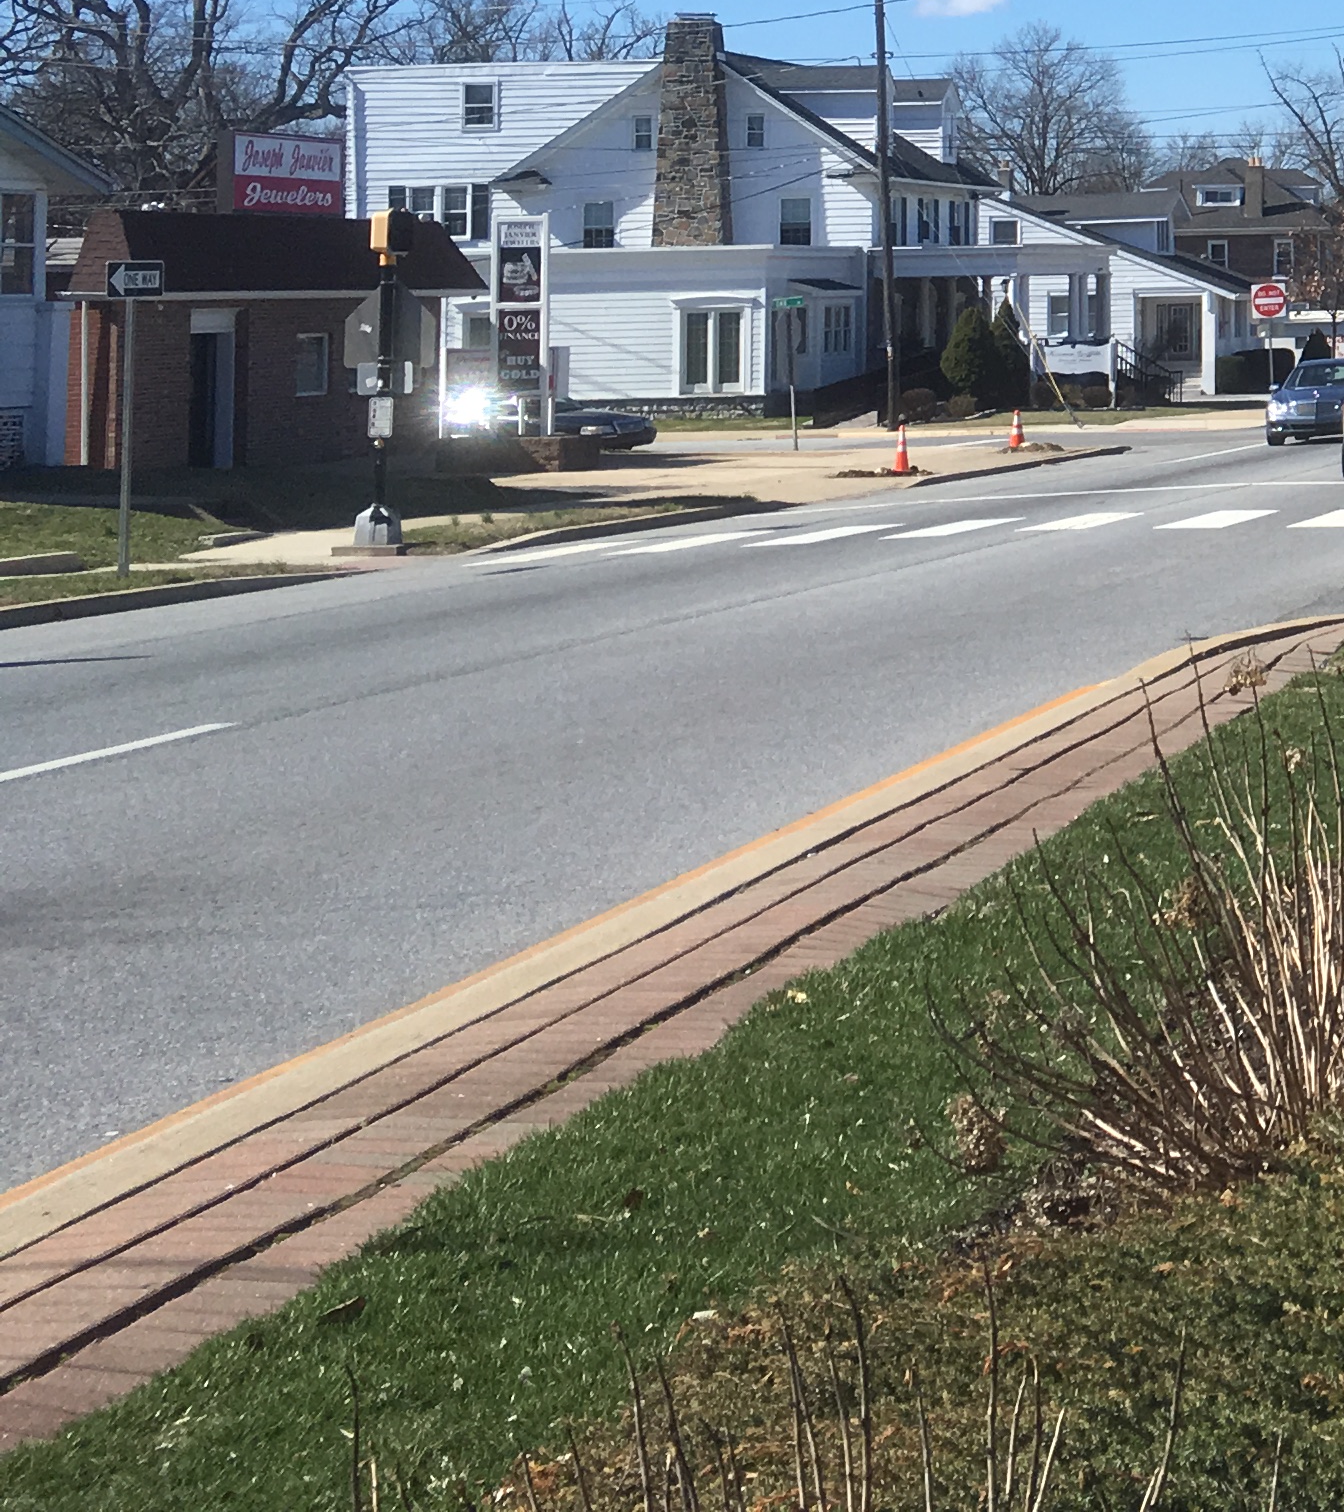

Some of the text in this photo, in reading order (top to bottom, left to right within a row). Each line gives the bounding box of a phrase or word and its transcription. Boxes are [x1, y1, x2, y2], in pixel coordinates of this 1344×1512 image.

[241, 139, 284, 175] Joseph
[243, 182, 333, 207] Jewelers
[124, 272, 158, 287] ONE WAY
[503, 315, 536, 331] 0%
